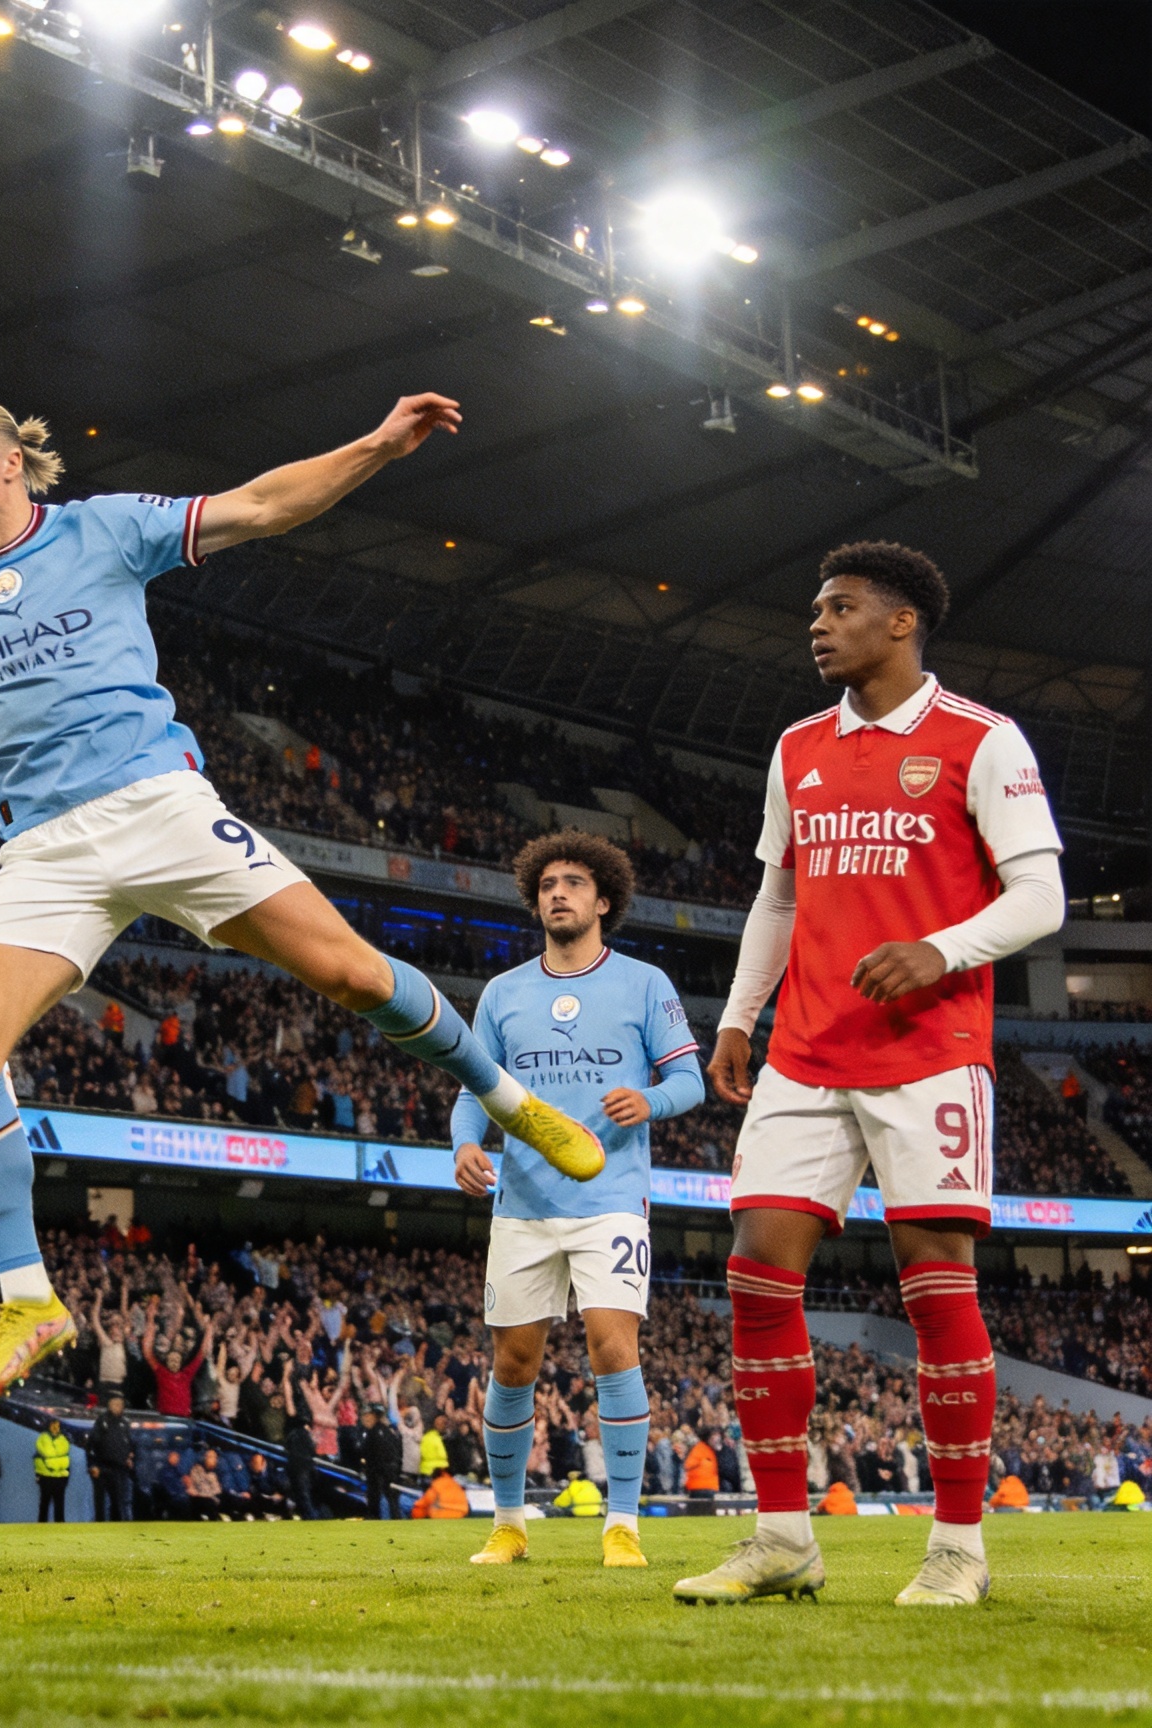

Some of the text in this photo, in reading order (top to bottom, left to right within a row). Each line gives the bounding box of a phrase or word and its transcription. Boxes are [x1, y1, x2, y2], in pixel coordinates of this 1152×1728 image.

[211, 818, 256, 858] 9
[793, 803, 936, 845] Emirates
[934, 1102, 970, 1160] 9
[611, 1235, 649, 1276] 20
